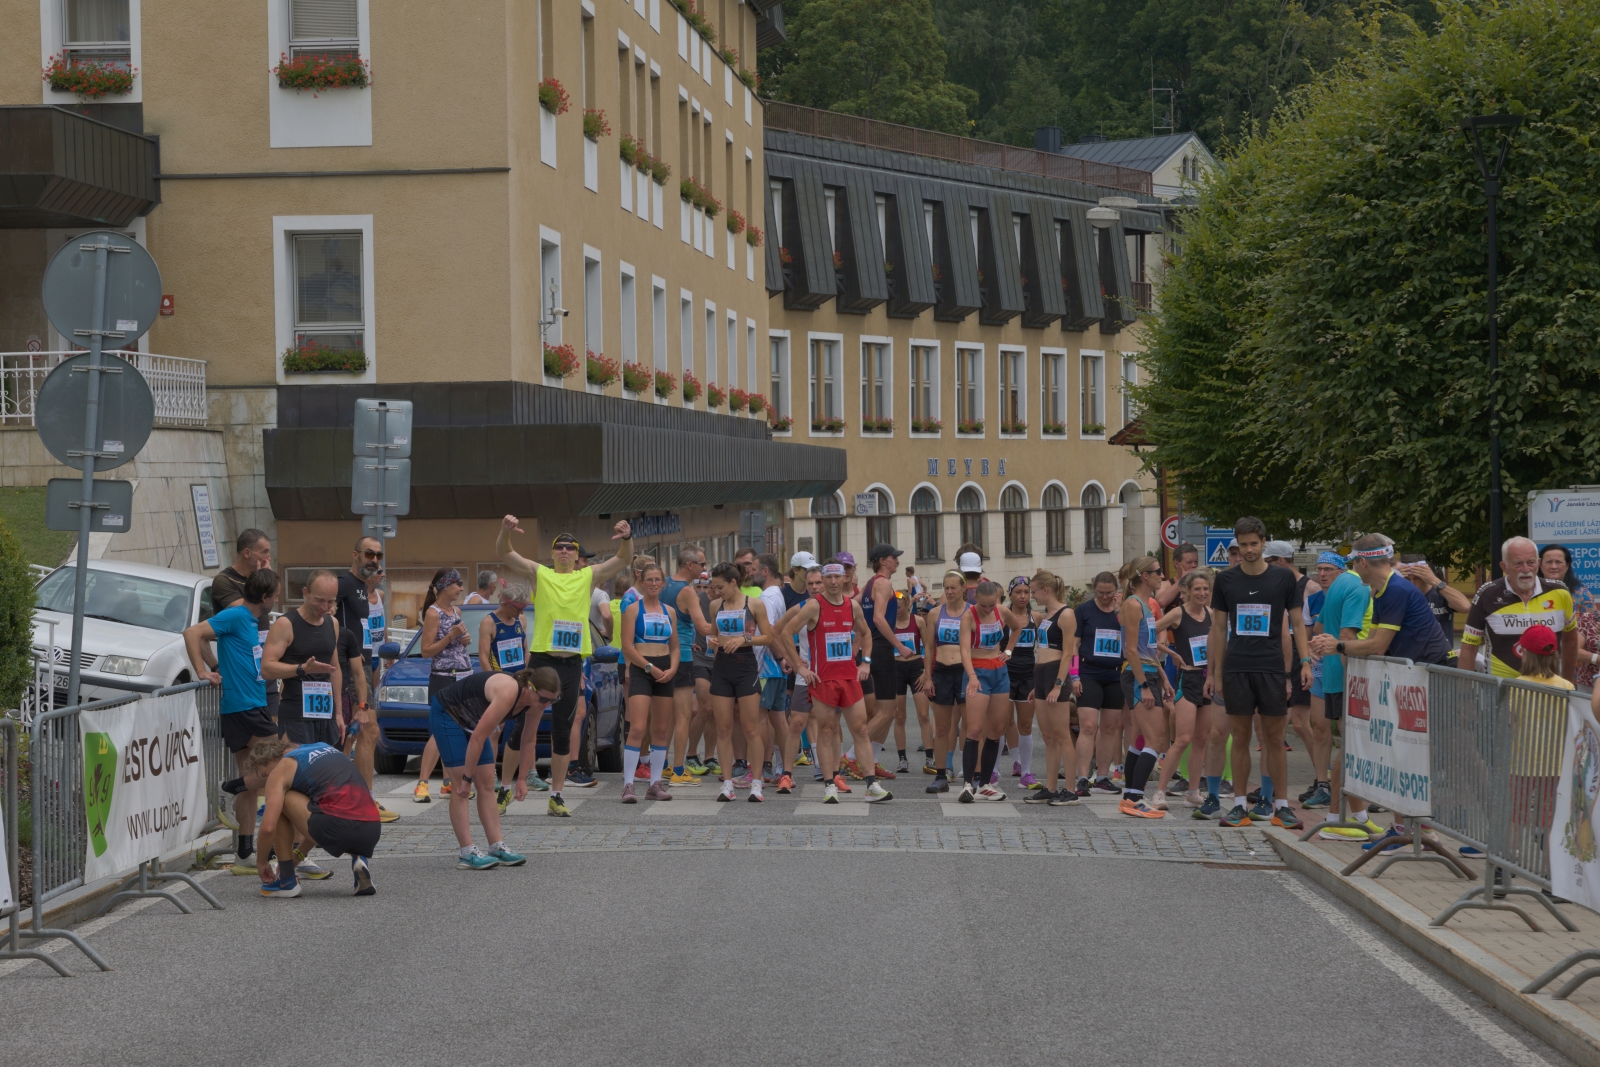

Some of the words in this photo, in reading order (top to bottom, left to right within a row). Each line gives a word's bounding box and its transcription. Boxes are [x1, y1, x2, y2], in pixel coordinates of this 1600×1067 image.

[927, 457, 1006, 476] MEYRA
[1534, 520, 1556, 528] STÁTNÍ
[1557, 519, 1586, 528] LÉČEBNÉ
[1553, 528, 1578, 536] JANSKÉ
[372, 616, 382, 629] 97
[653, 622, 665, 637] 17
[722, 618, 739, 633] 34
[1244, 615, 1262, 631] 85
[1503, 616, 1556, 628] Whirlpool
[557, 630, 580, 648] 109
[943, 628, 960, 642] 63
[984, 630, 1002, 647] 142
[830, 642, 849, 657] 107
[1099, 638, 1119, 654] 140
[505, 648, 520, 664] 64
[308, 694, 331, 713] 133
[1399, 771, 1429, 802] SPORT
